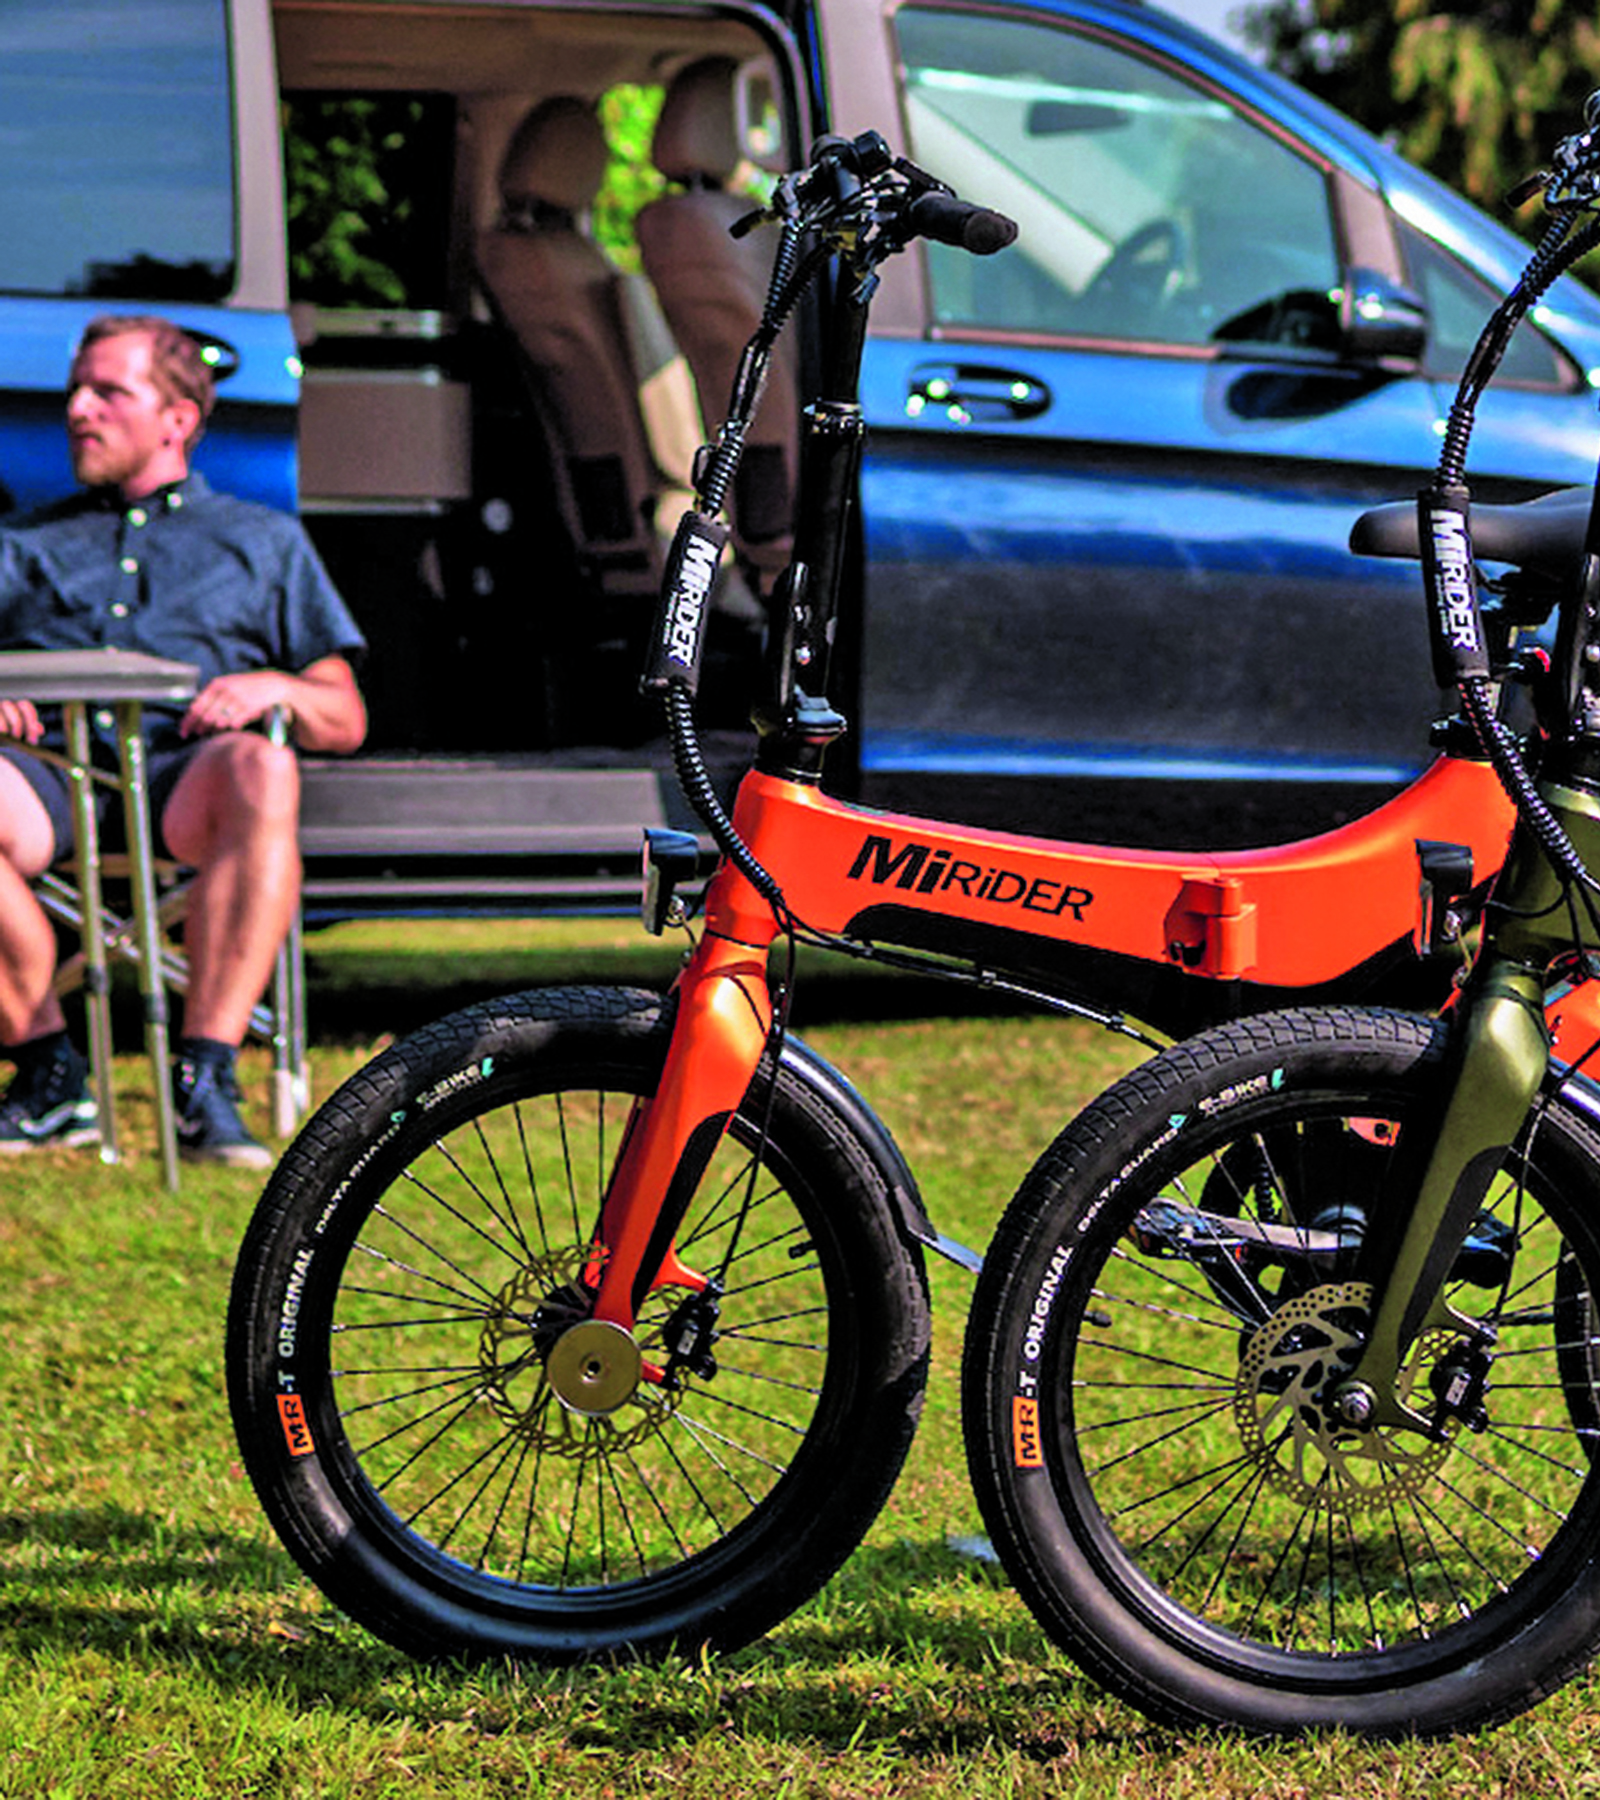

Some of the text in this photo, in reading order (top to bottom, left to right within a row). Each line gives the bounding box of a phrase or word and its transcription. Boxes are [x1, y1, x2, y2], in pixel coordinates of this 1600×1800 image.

[279, 1249, 314, 1358] ORIGINAL
[1024, 1245, 1073, 1360] ORIGINAL
[1078, 1179, 1121, 1232] DELTA
[1120, 1128, 1178, 1179] GUARD
